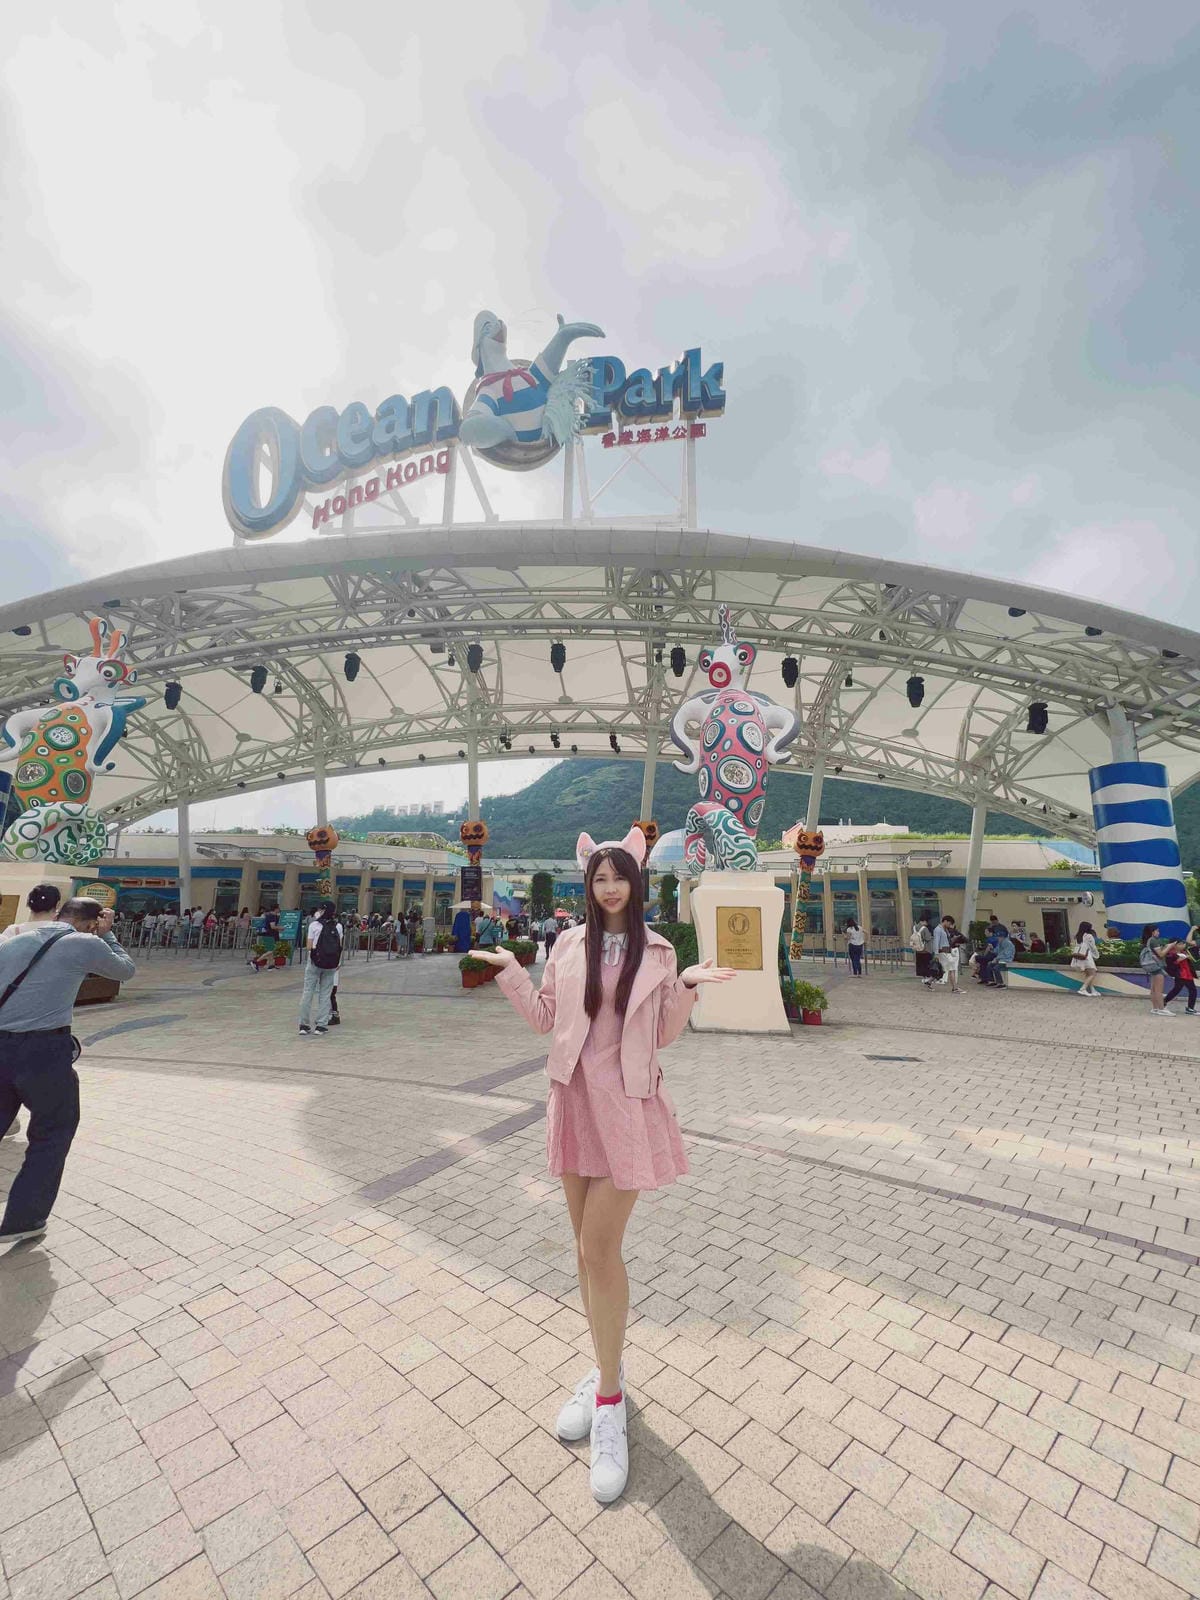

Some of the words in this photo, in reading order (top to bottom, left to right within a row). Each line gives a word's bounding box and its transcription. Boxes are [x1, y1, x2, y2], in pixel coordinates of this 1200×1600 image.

[223, 386, 461, 538] Ocean
[580, 347, 726, 427] Park
[312, 477, 380, 530] Hong
[386, 449, 450, 491] Kong
